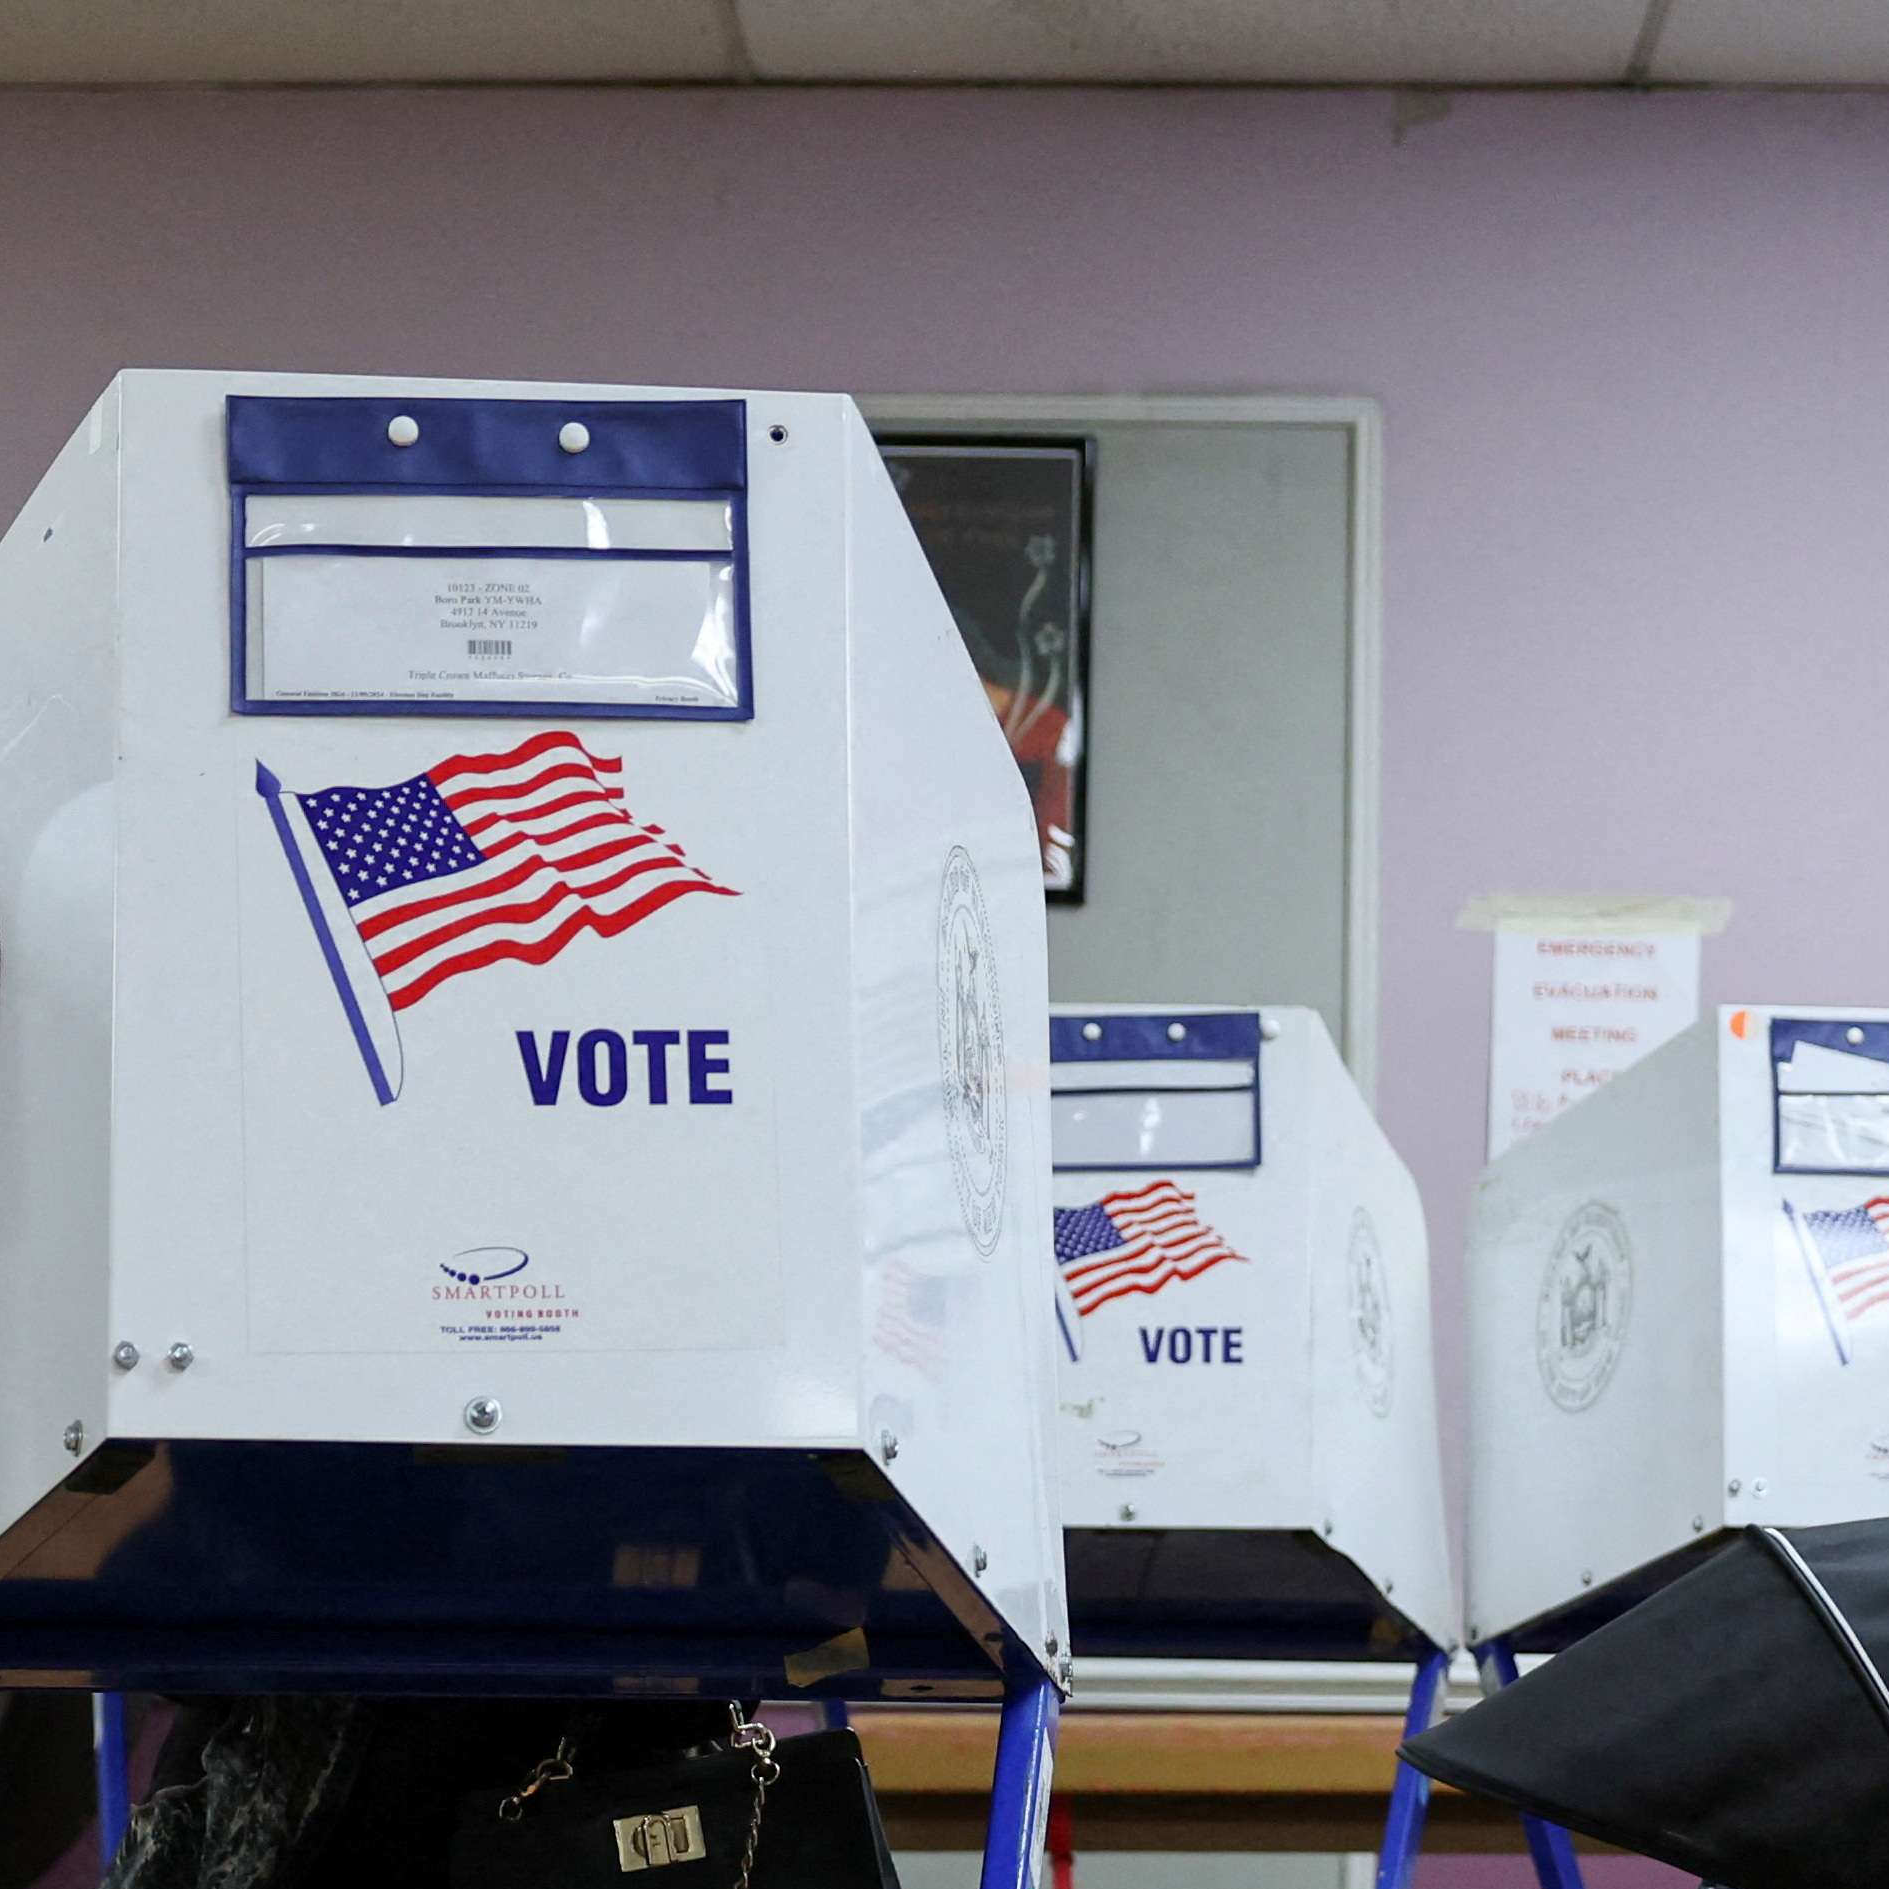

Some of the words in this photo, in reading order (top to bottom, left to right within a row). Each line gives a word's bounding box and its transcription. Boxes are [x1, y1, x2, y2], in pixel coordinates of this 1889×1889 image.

[485, 583, 515, 593] ZONE
[461, 595, 482, 605] Park
[491, 608, 527, 617] Avenue
[489, 619, 505, 629] NY
[509, 619, 538, 629] 11219
[515, 1029, 733, 1106] VOTE
[1561, 1069, 1611, 1086] PLAC
[432, 1285, 565, 1300] SMARTPOLL
[486, 1310, 533, 1319] VOTING
[538, 1309, 579, 1318] BOOTH
[440, 1326, 465, 1334] TOLL
[1141, 1327, 1244, 1364] VOTE
